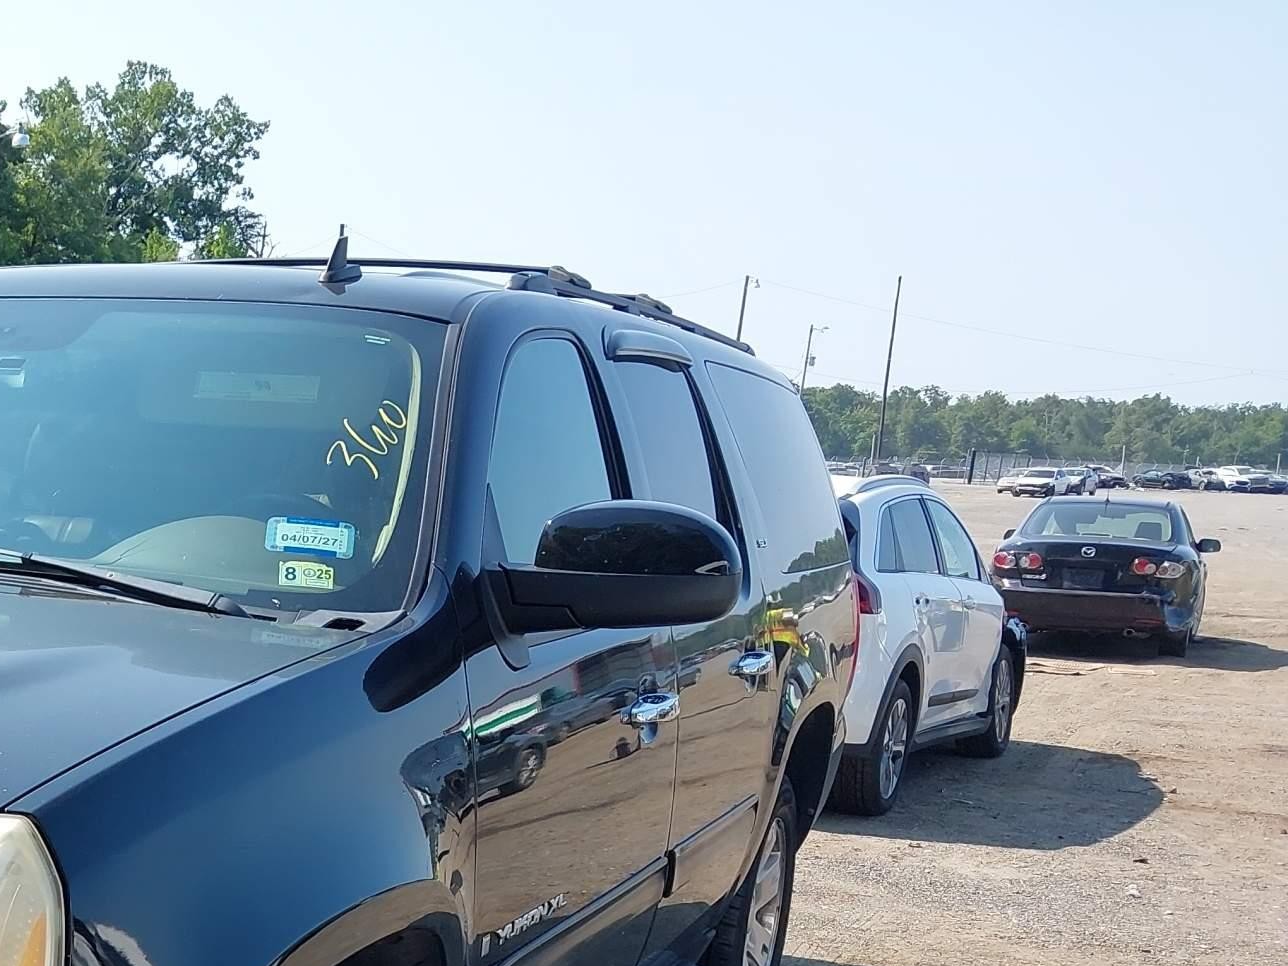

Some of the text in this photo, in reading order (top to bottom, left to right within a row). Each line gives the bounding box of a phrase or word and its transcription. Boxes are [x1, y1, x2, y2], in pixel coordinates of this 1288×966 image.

[281, 533, 339, 547] 04/07/27
[284, 566, 332, 581] 8 25
